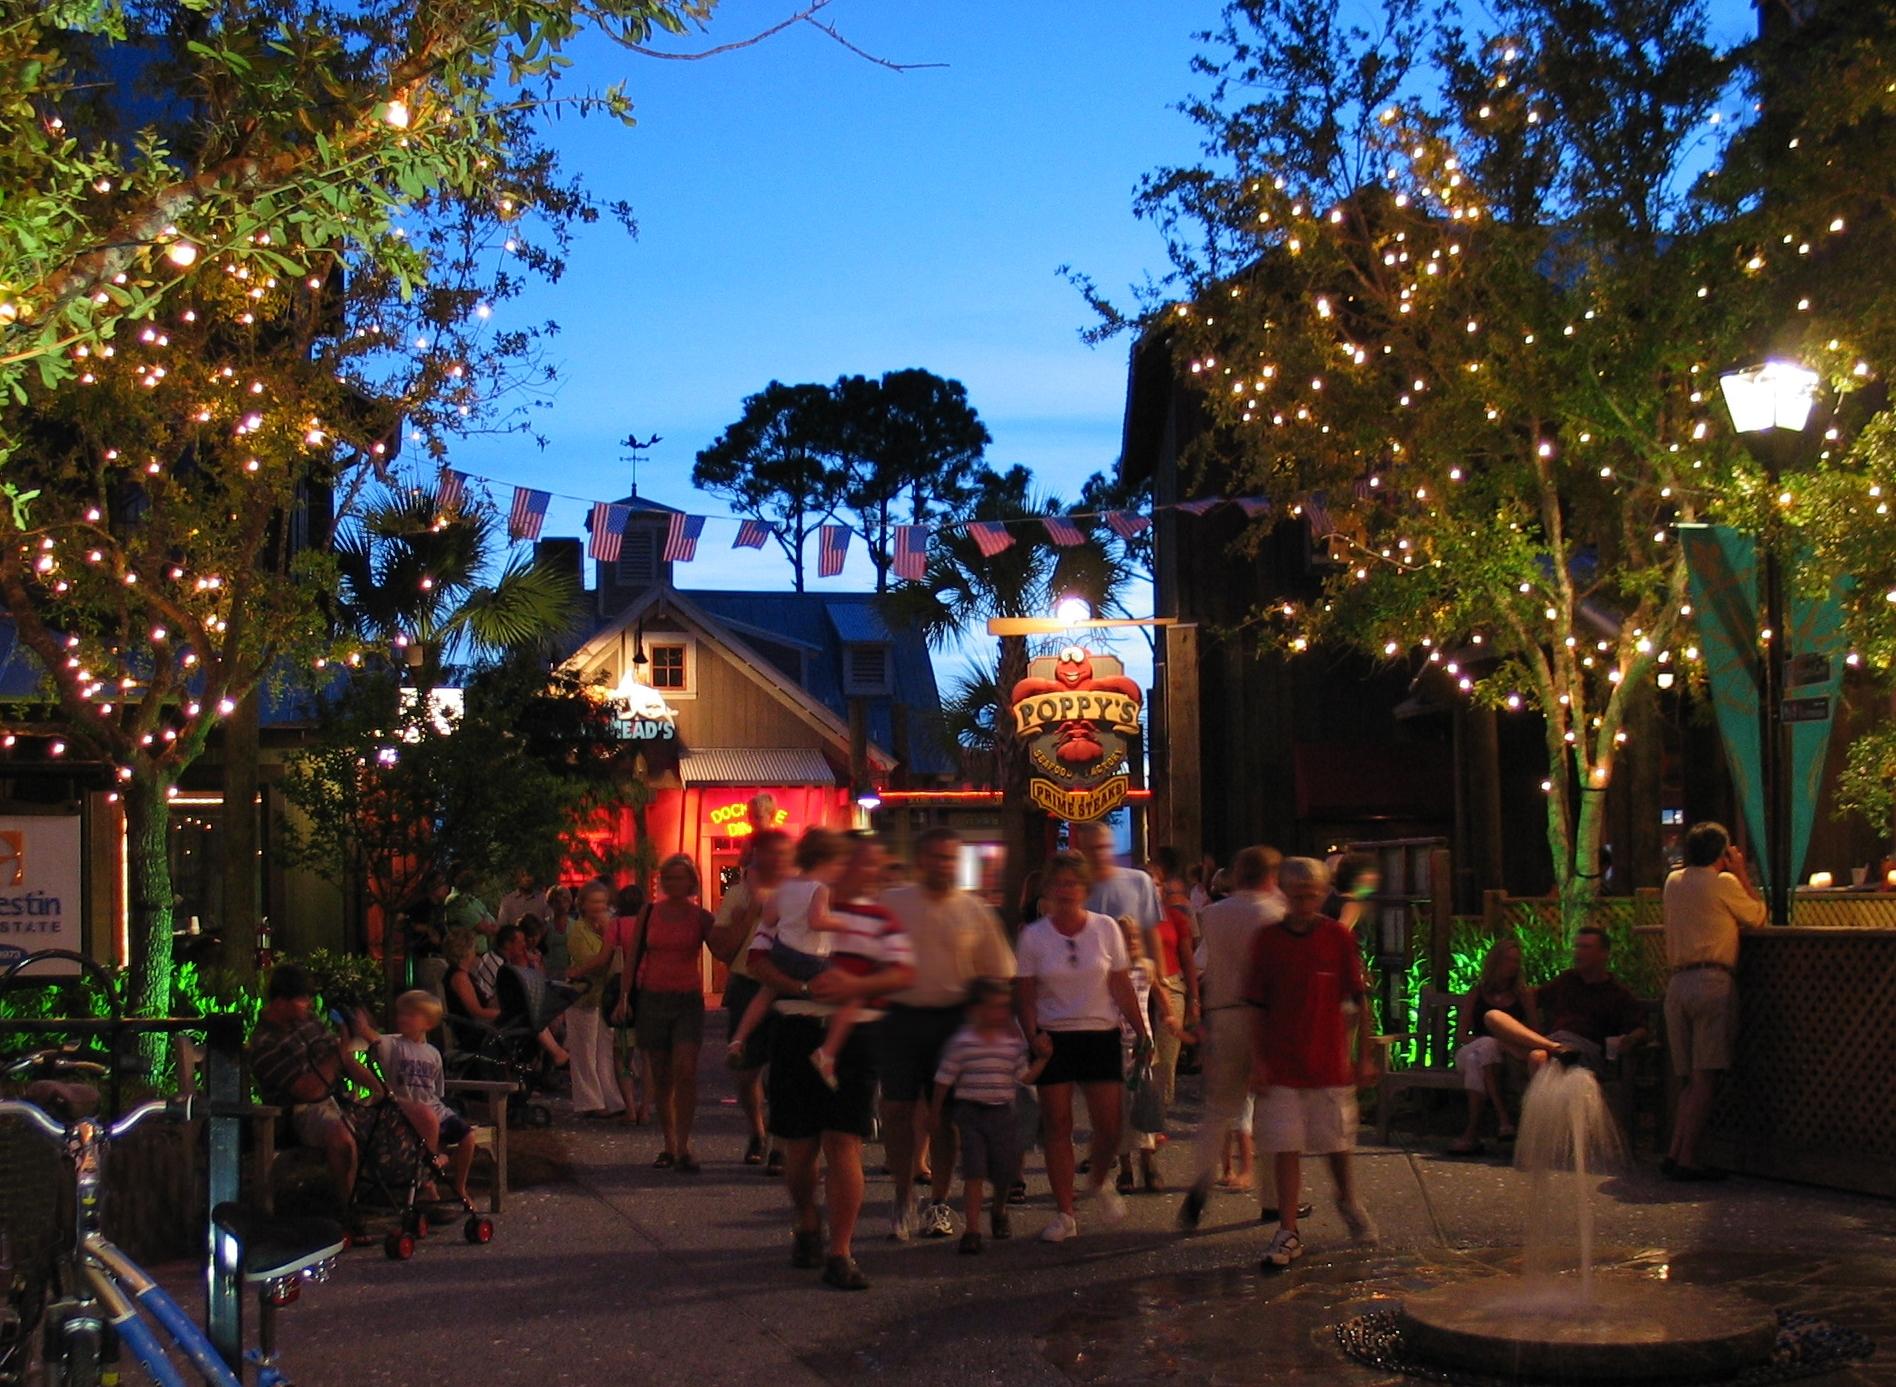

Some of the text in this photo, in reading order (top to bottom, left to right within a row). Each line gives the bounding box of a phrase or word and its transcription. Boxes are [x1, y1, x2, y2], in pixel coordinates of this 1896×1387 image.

[1018, 696, 1136, 727] POPPY'S
[1085, 748, 1123, 777] ACTORY
[1036, 783, 1123, 816] PRIME STEAKS
[0, 921, 62, 933] STATE
